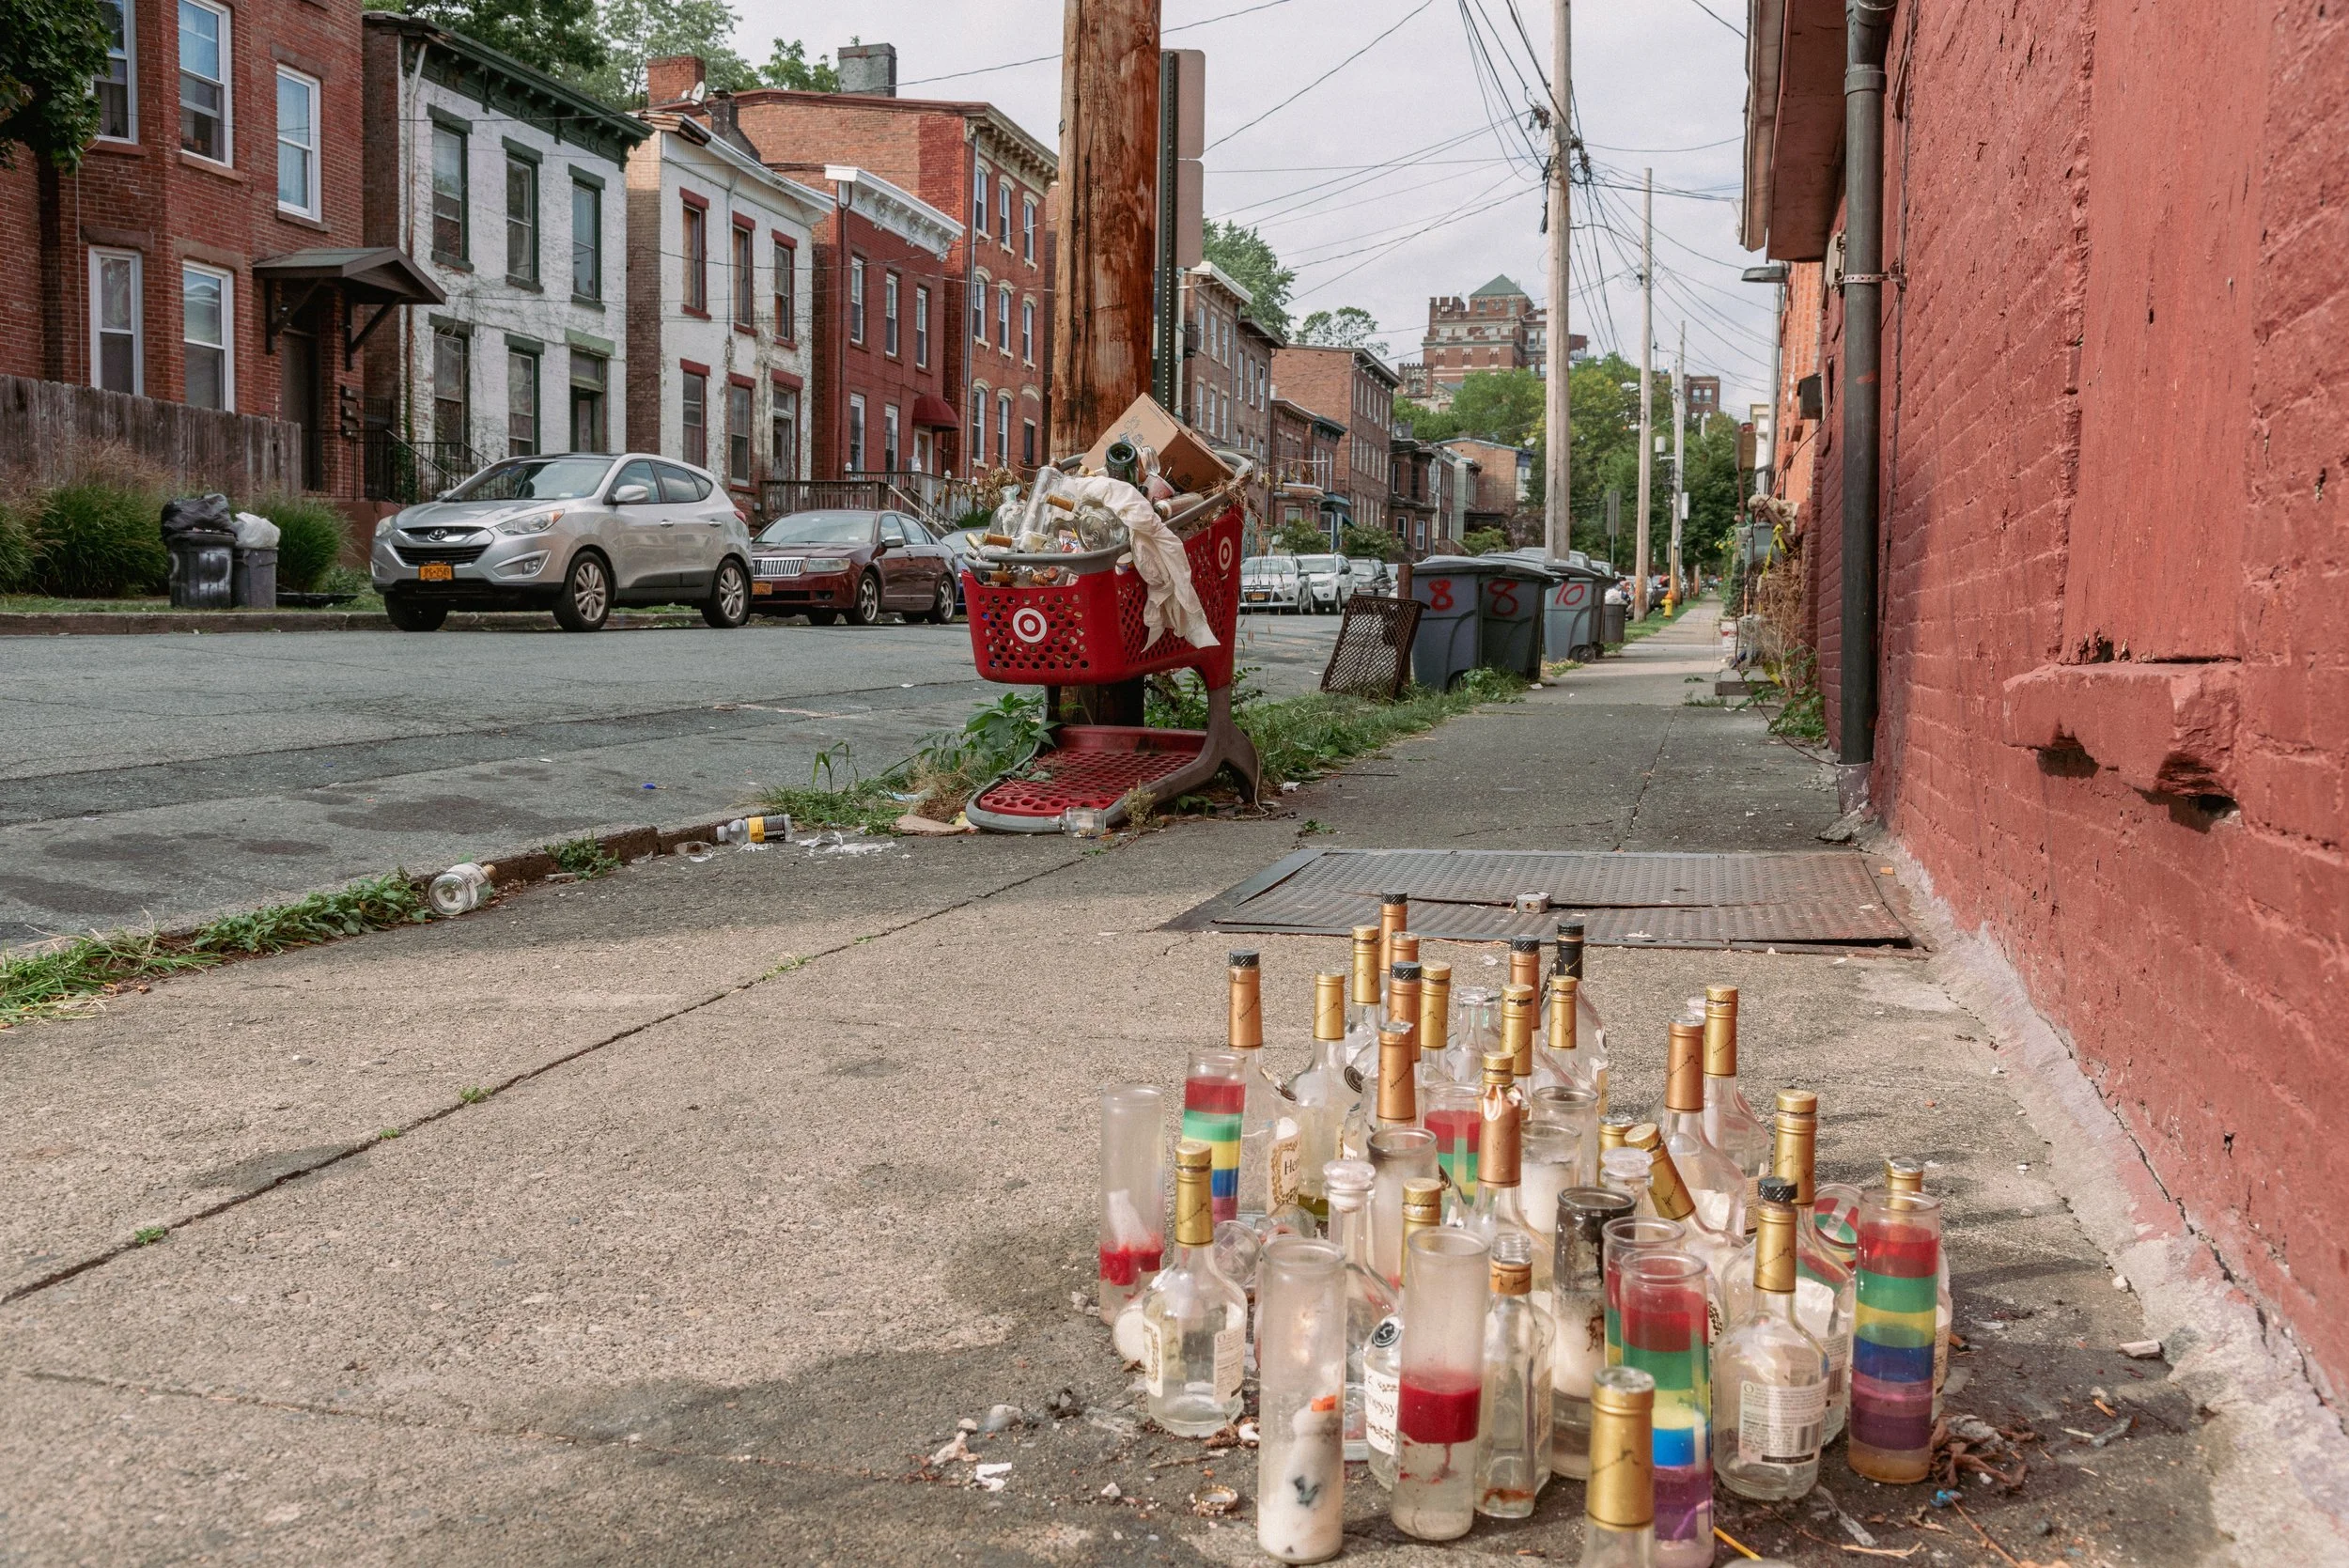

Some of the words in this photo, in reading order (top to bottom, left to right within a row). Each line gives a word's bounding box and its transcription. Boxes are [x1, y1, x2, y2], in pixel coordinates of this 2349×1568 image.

[1428, 578, 1455, 612] 8
[1487, 578, 1519, 616] 8
[1554, 582, 1585, 606] 10
